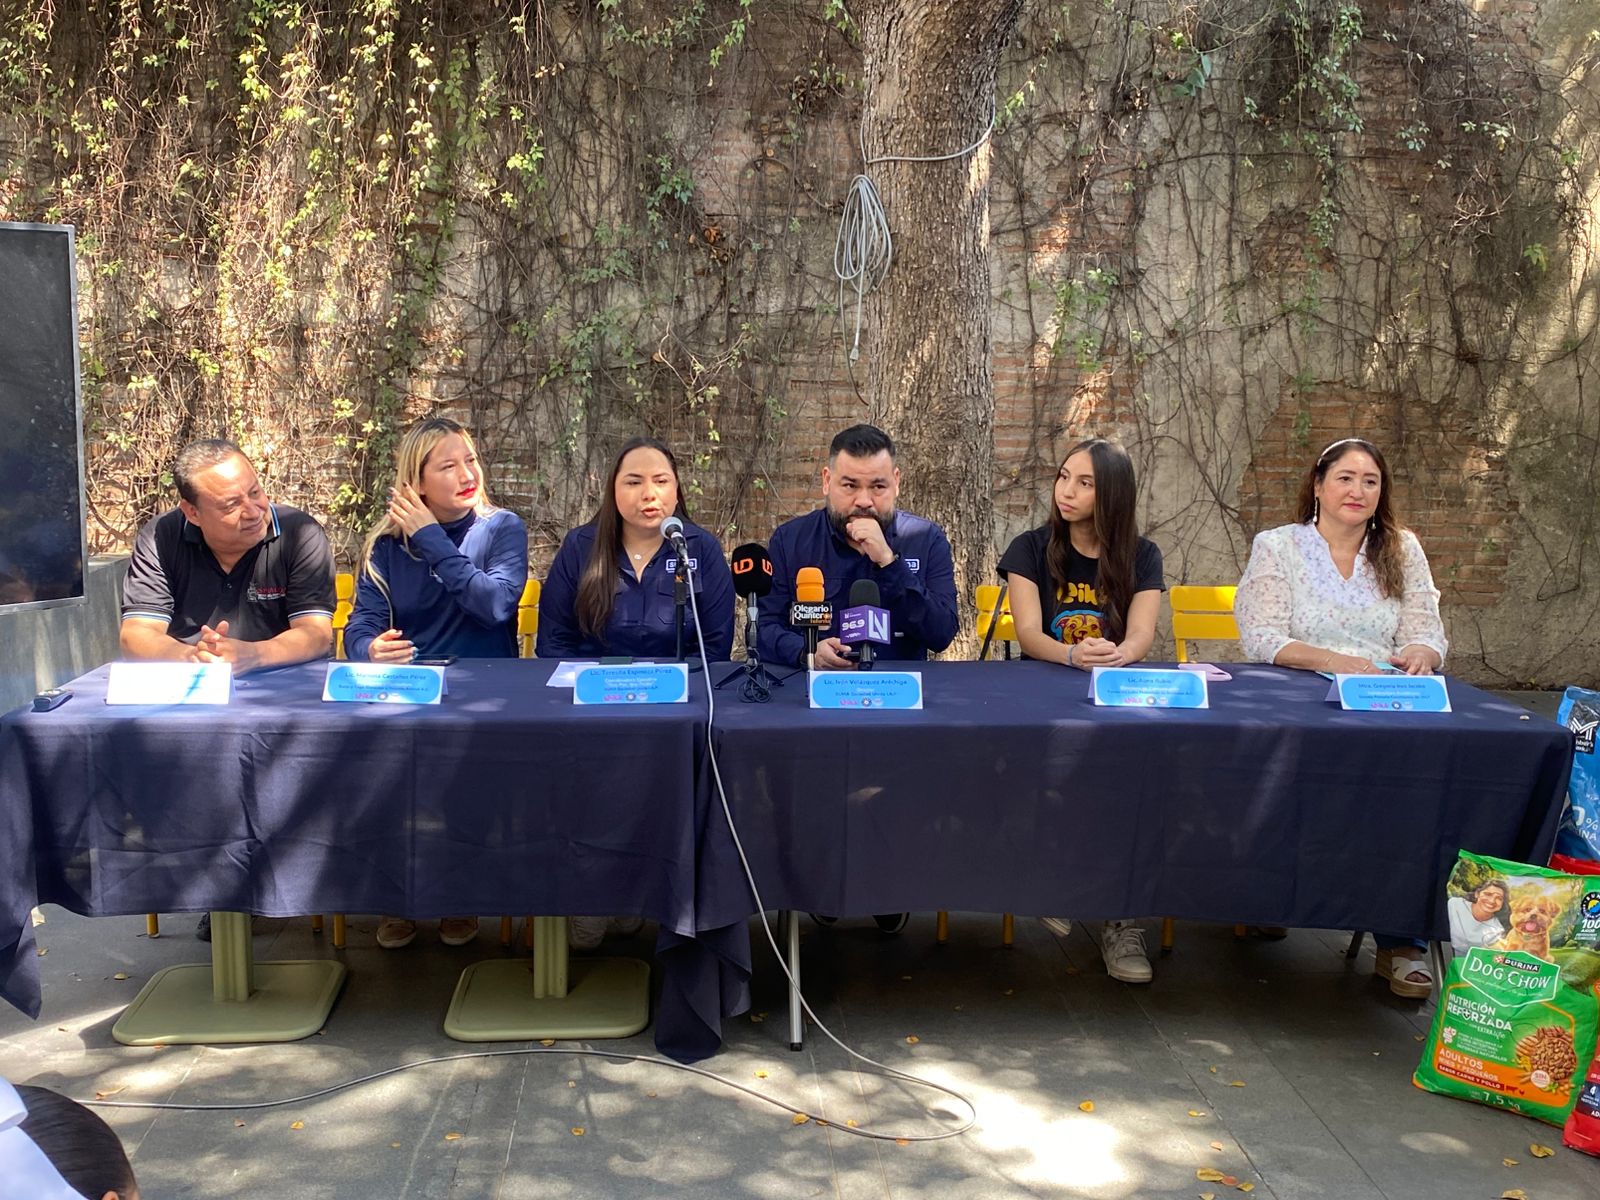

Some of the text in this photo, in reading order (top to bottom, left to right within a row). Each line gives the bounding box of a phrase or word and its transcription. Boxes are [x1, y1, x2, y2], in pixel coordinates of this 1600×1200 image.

[794, 604, 829, 614] Olegario
[1469, 956, 1504, 980] DOG
[1504, 958, 1539, 972] PURINA
[1448, 993, 1496, 1016] NUTRICIÓN
[1439, 1047, 1484, 1070] ADULTOS
[1481, 1079, 1501, 1089] POLLO
